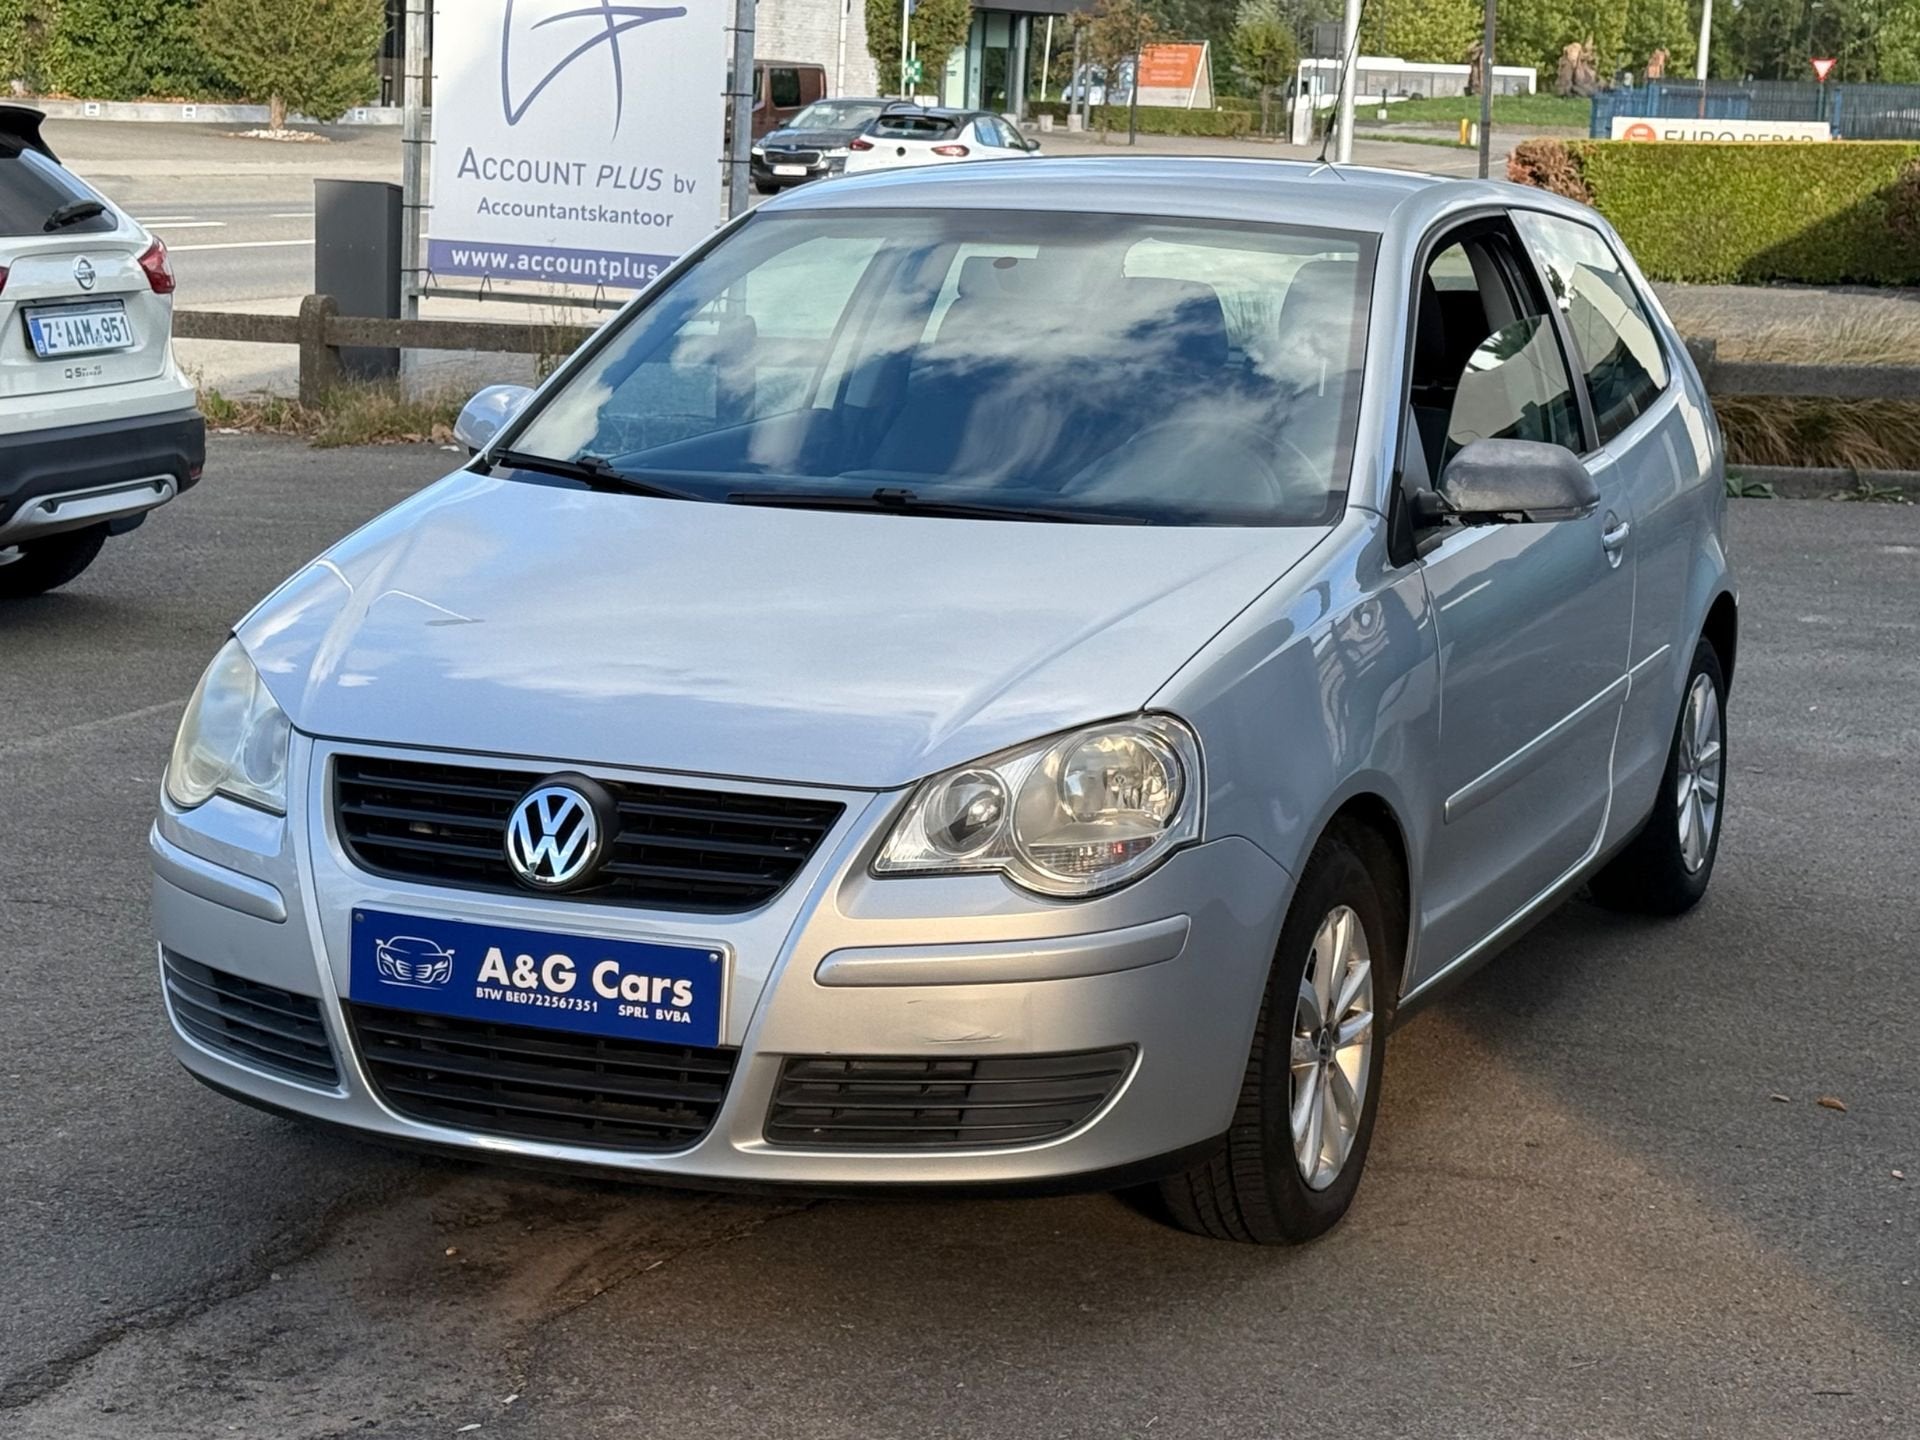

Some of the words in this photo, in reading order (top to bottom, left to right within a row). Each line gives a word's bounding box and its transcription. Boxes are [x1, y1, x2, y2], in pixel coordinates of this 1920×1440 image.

[457, 147, 587, 186] ACCOUNT
[596, 164, 664, 192] PLUS
[673, 173, 696, 195] bv
[477, 197, 674, 228] Accountantskantoor
[477, 946, 577, 993] A&G
[592, 960, 693, 1008] Cars
[475, 986, 503, 1001] BTW
[505, 990, 598, 1013] BE0722567351
[618, 1004, 649, 1019] SPRL
[655, 1008, 691, 1024] BVBA
